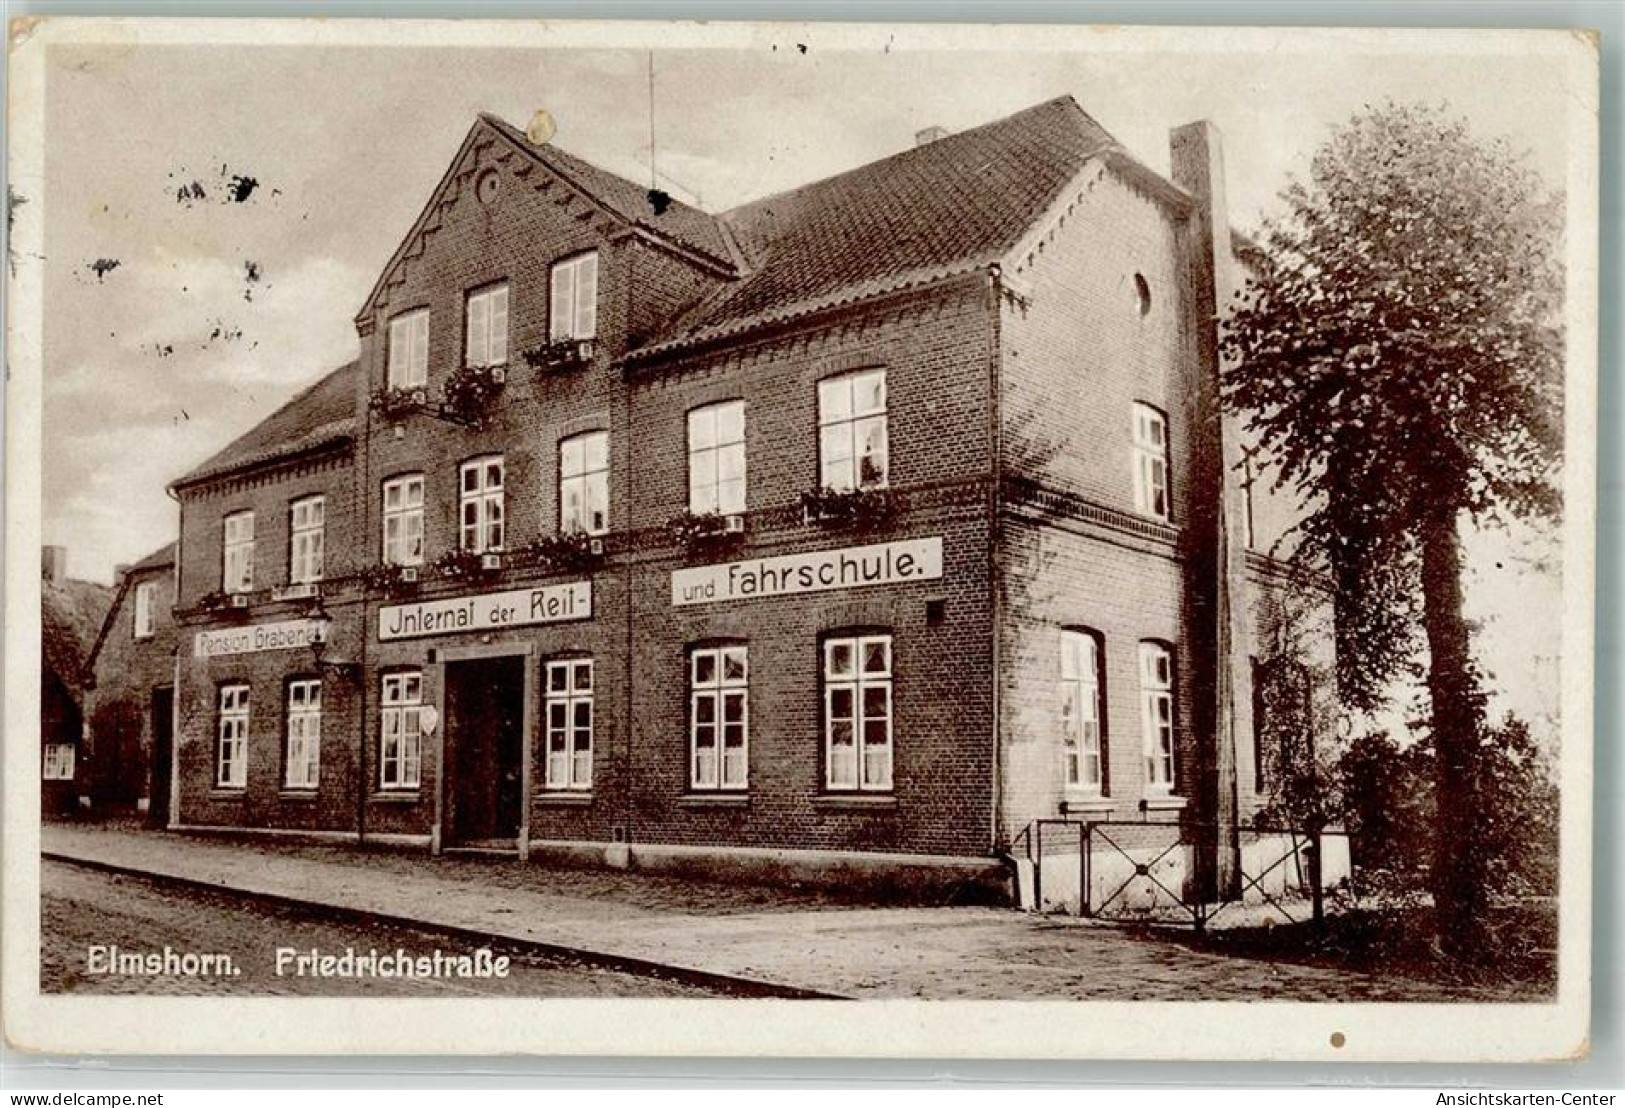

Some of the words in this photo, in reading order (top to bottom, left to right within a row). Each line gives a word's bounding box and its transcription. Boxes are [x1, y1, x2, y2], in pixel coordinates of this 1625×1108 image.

[682, 578, 715, 601] und
[727, 547, 924, 595] Fahrschule.
[489, 604, 516, 623] der
